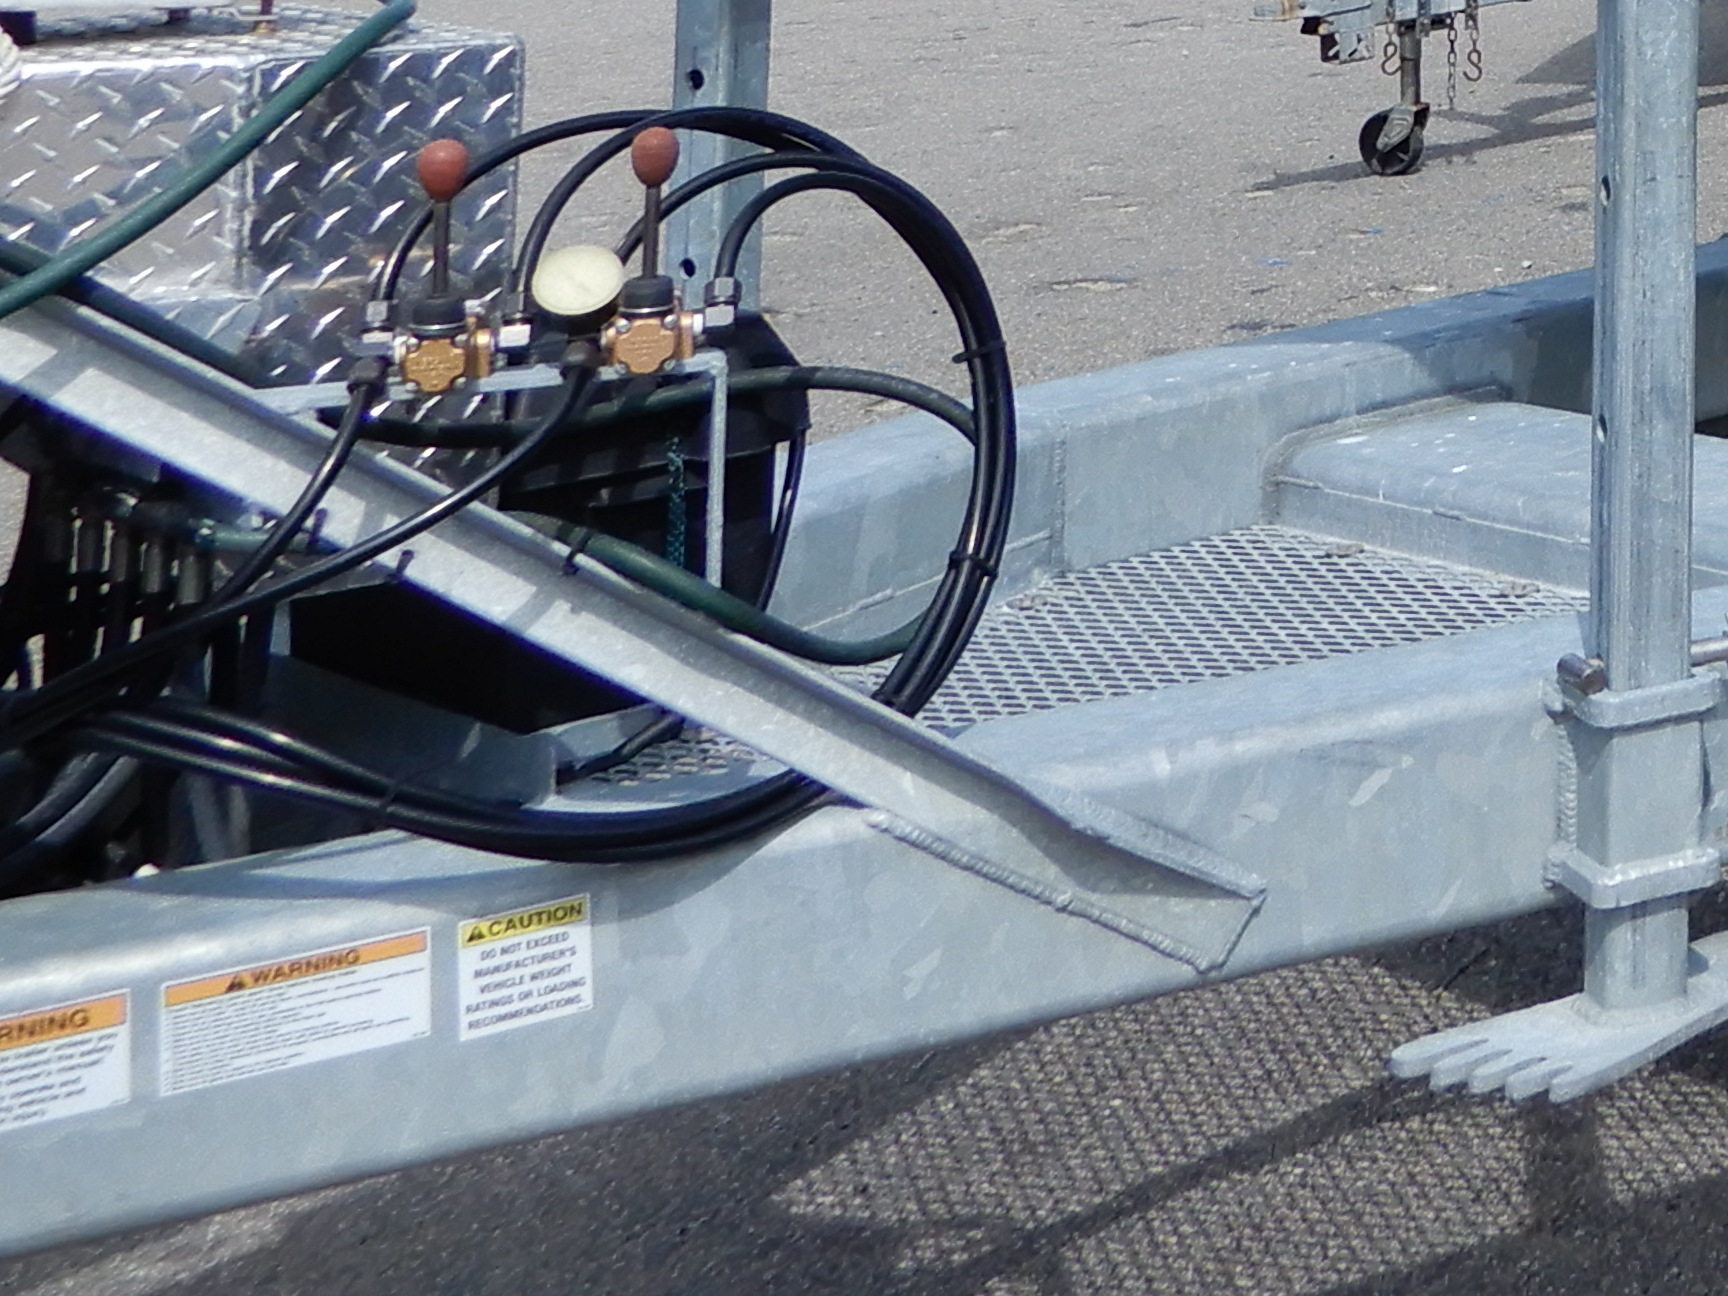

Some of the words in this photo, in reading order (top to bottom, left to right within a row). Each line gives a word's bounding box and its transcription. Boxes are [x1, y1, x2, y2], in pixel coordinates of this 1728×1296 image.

[488, 902, 582, 936] CAUTION
[480, 948, 497, 961] DO
[500, 942, 522, 956] NOT
[526, 931, 570, 950] EXCEED
[253, 949, 360, 984] WARNING
[480, 974, 525, 994] VEHICLE
[530, 963, 572, 983] WEIGHT
[466, 994, 515, 1014] RATINGS
[537, 976, 586, 997] LOADING
